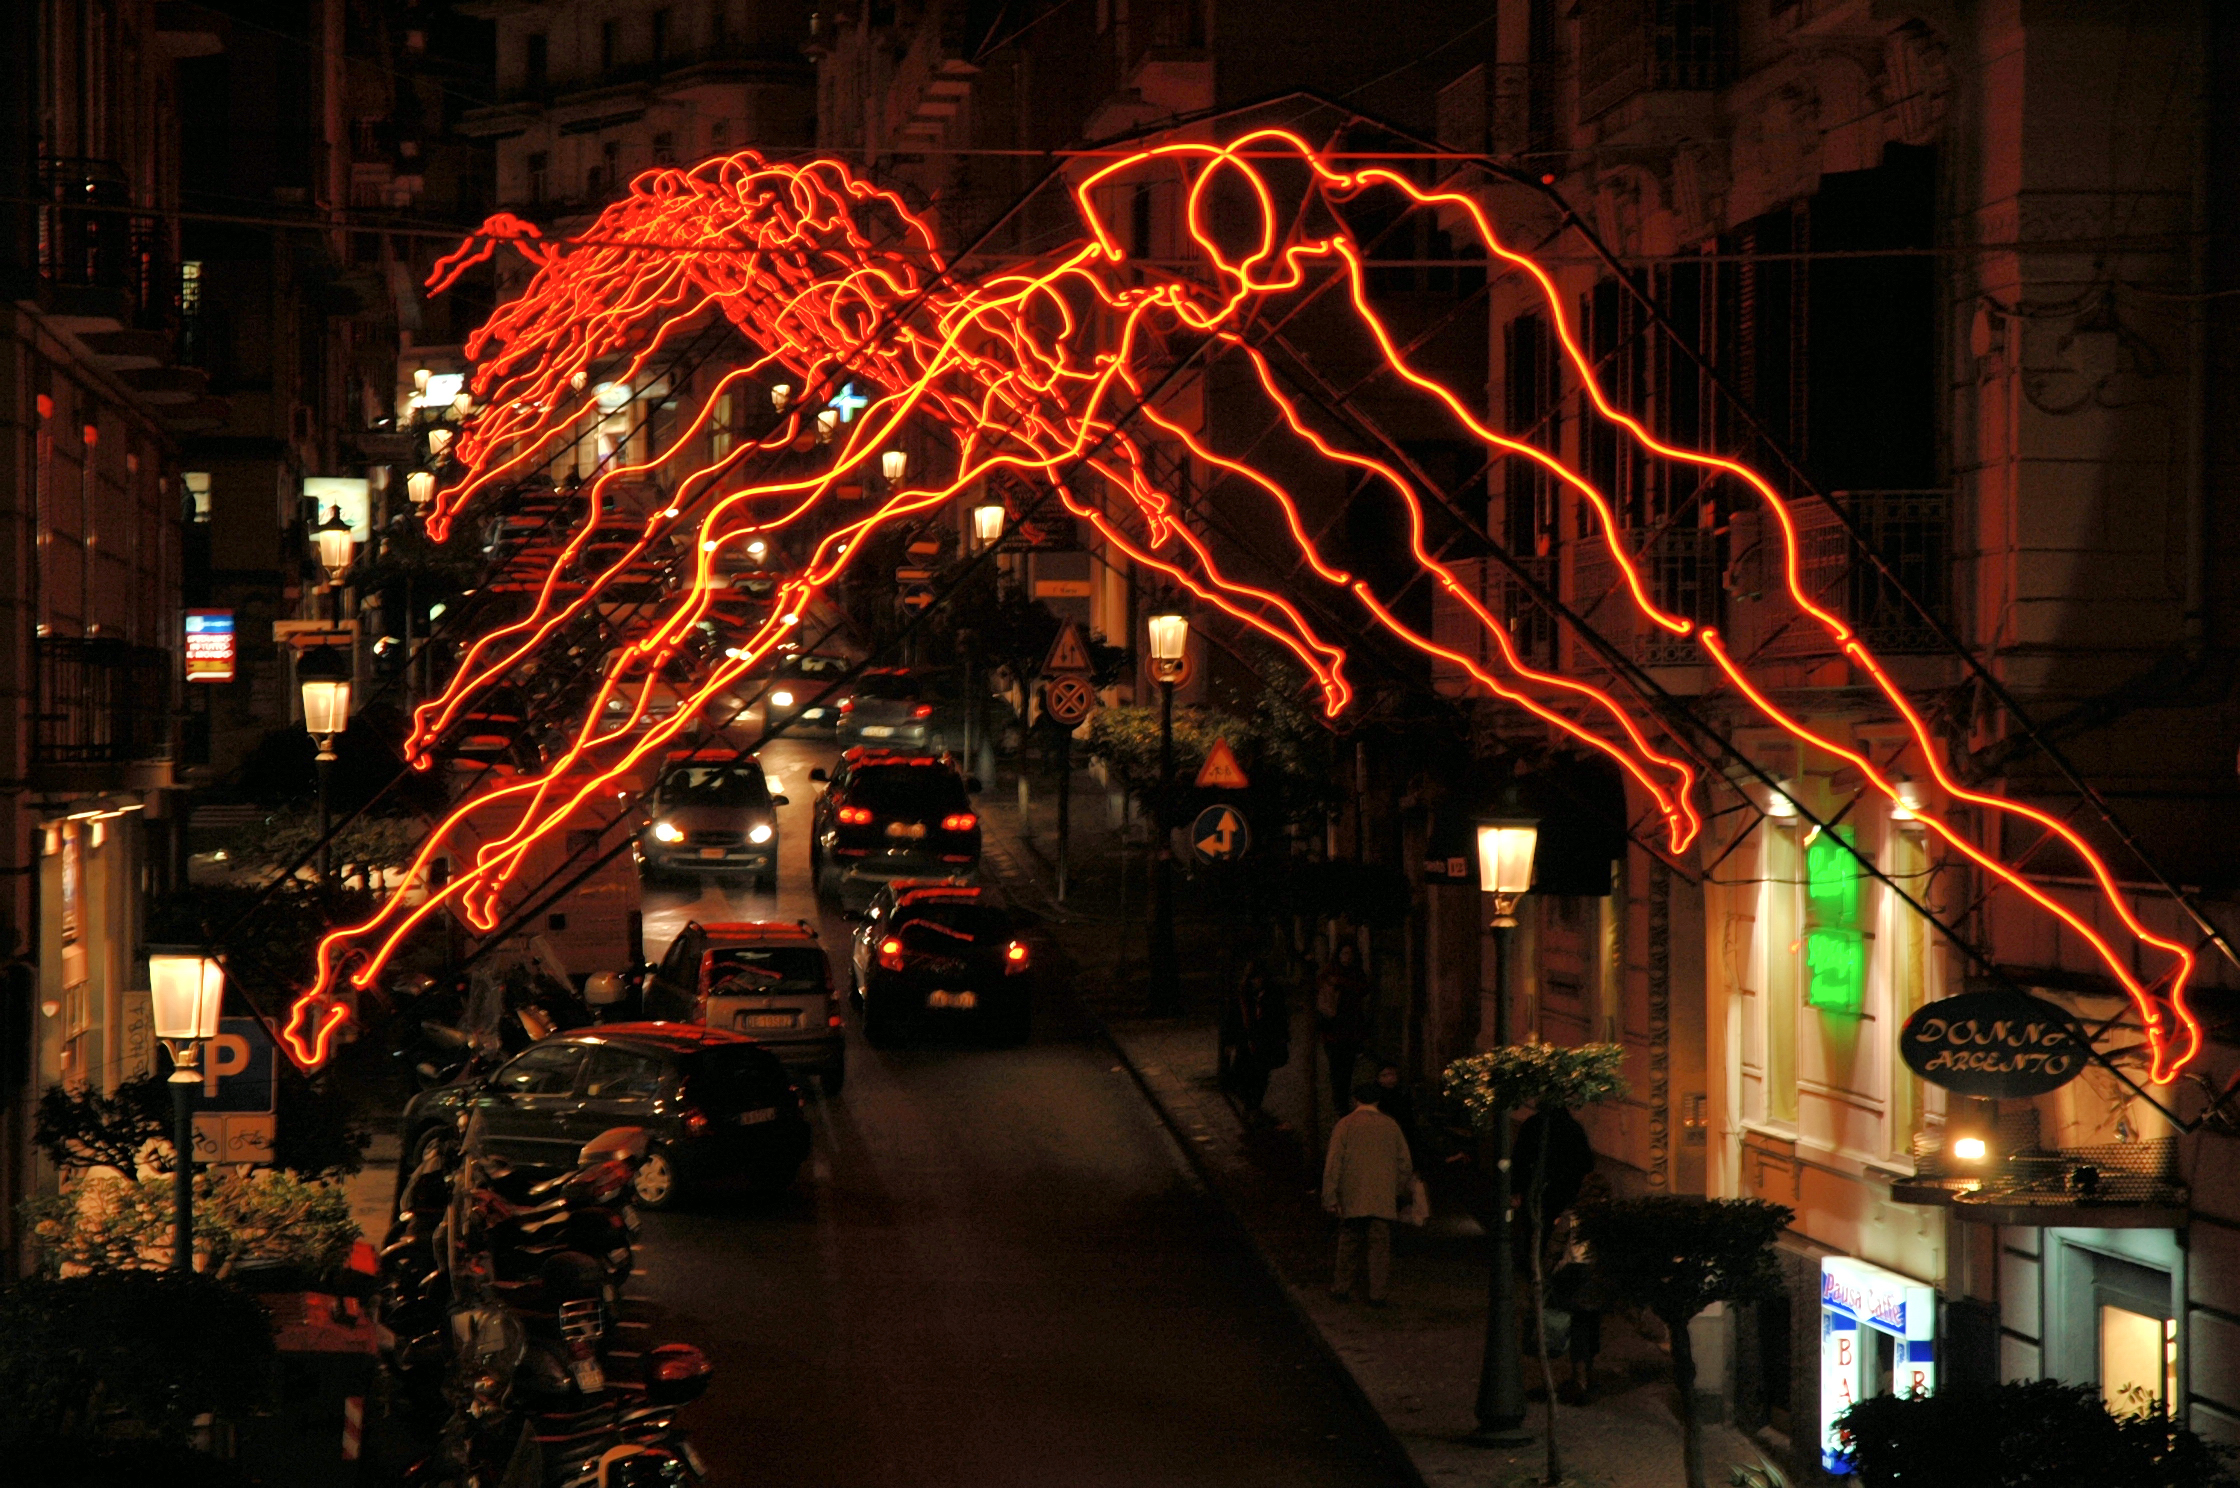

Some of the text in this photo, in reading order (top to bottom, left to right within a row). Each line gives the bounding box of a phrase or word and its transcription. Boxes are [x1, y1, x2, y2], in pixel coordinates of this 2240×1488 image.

[203, 1033, 251, 1098] P
[1925, 1050, 2071, 1075] ARGENTO
[1824, 1272, 1862, 1309] Pausa
